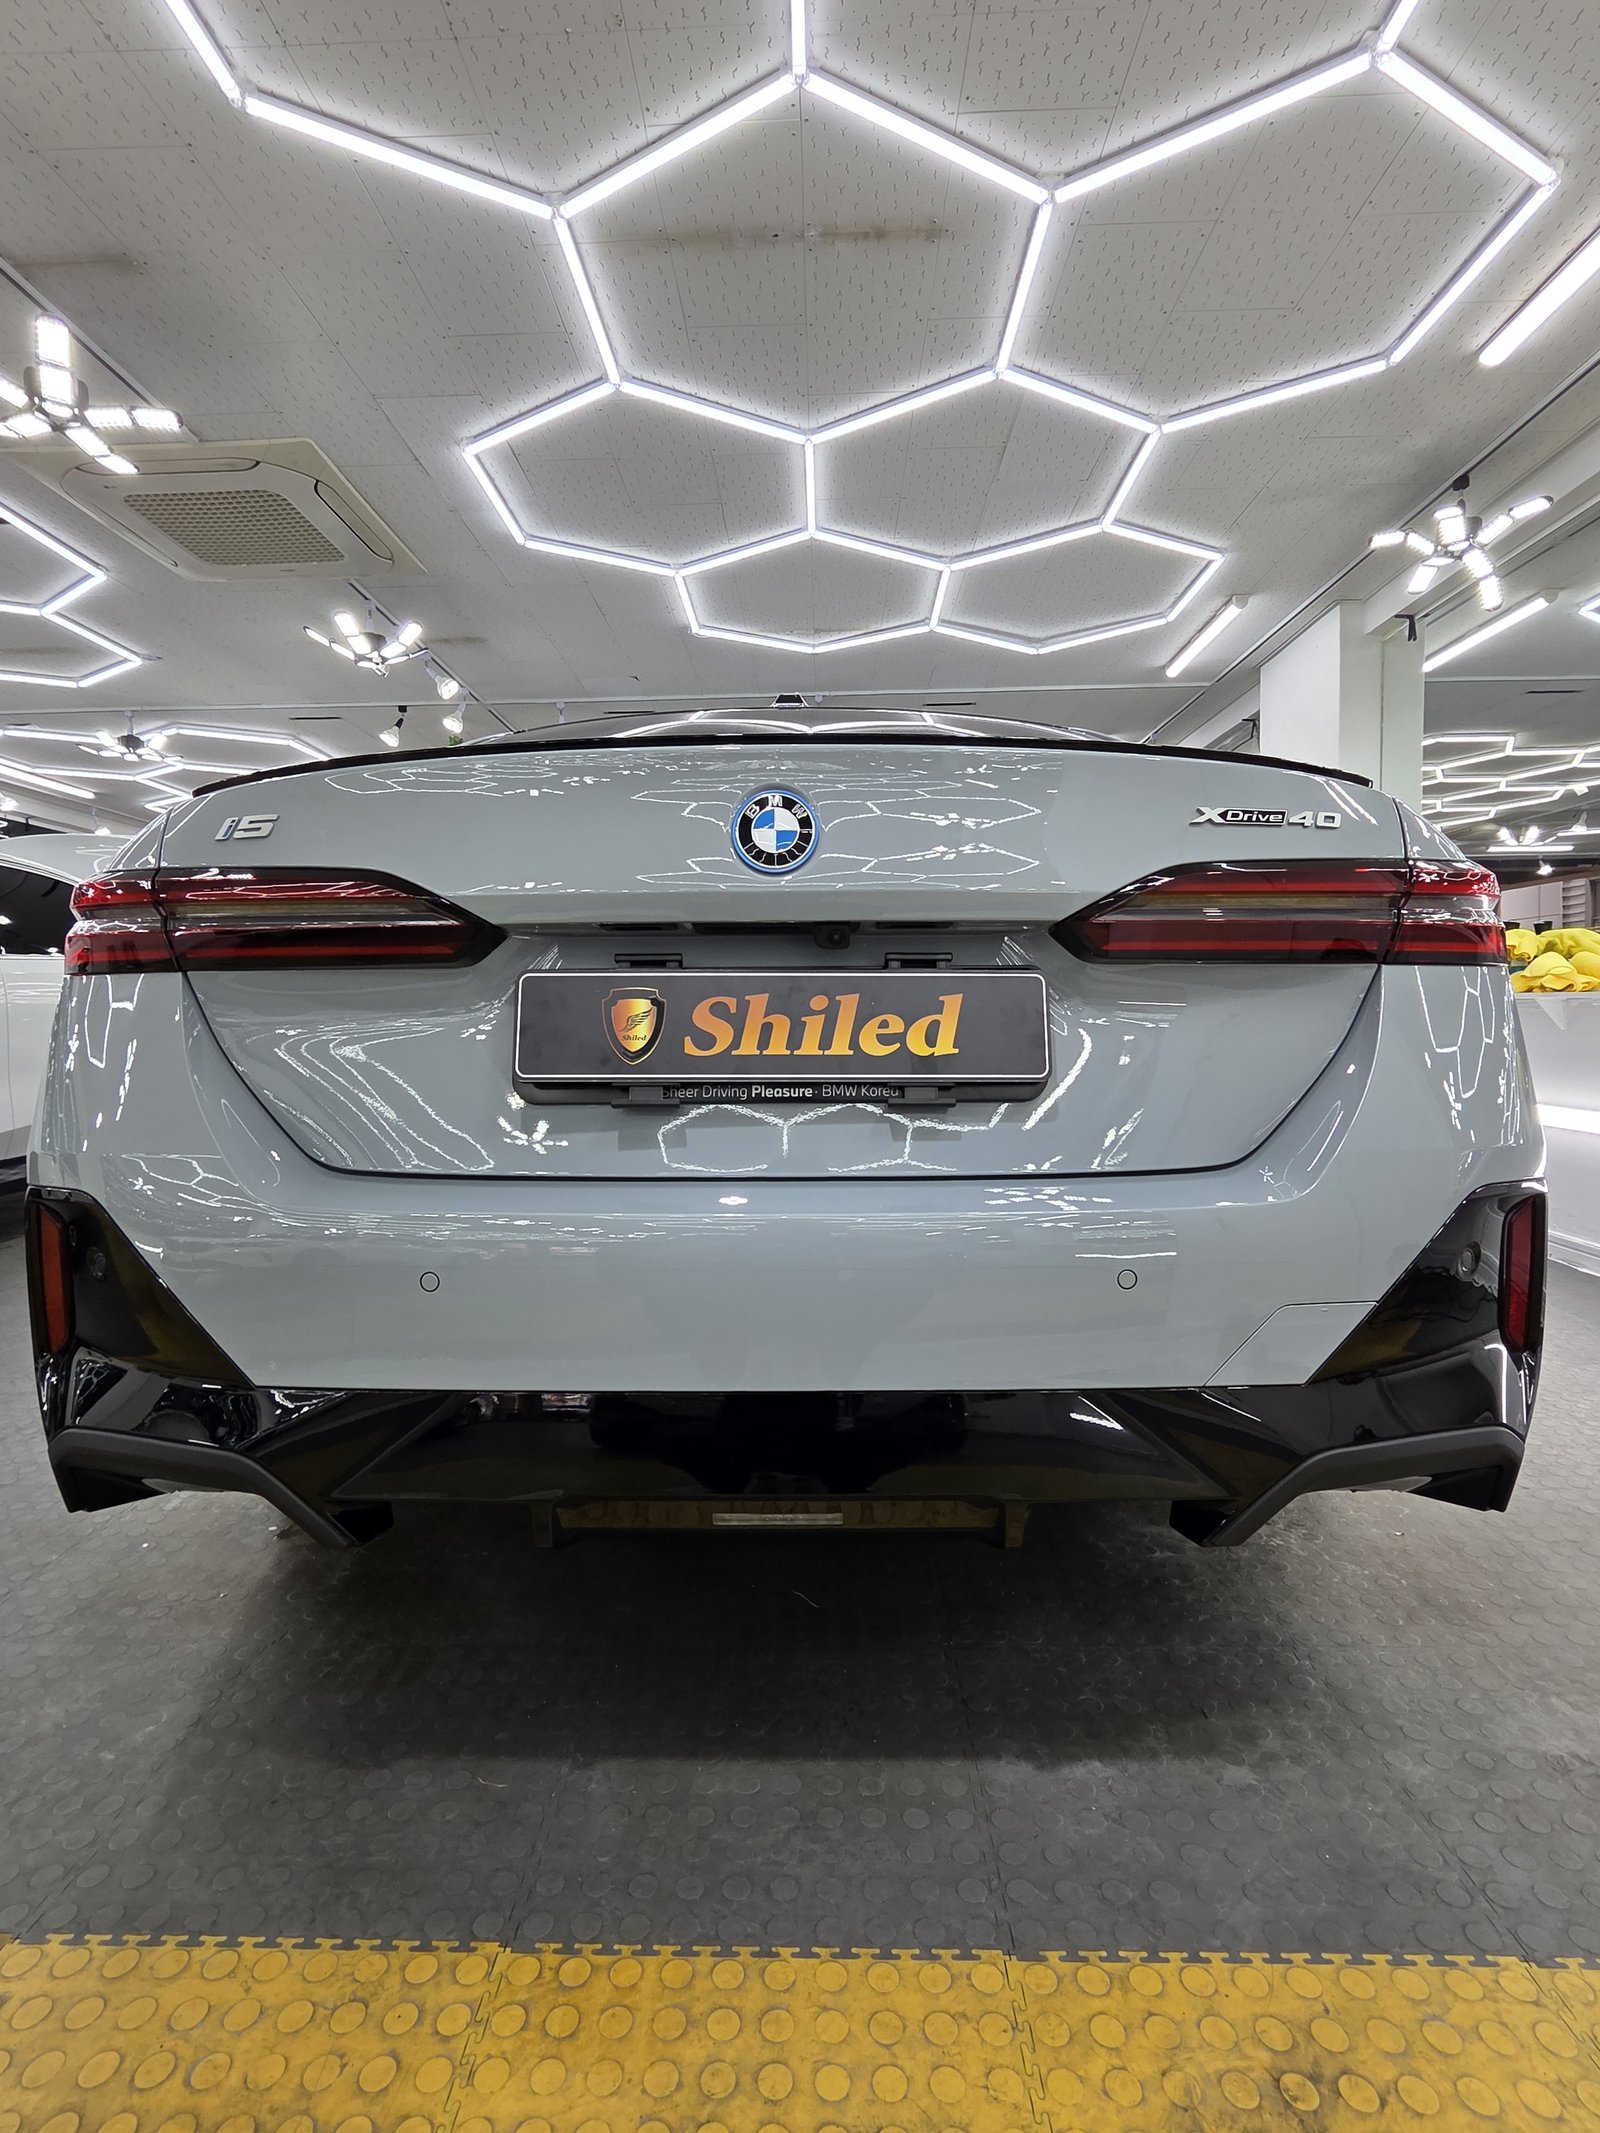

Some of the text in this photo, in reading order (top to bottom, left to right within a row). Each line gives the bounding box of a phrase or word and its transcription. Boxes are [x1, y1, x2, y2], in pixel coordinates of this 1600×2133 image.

[744, 795, 808, 820] BMW
[1288, 810, 1342, 829] 40
[213, 813, 280, 842] i5
[684, 992, 964, 1057] Shiled
[702, 1084, 748, 1101] Driving
[751, 1085, 813, 1098] Pleasure
[822, 1084, 857, 1097] BMW
